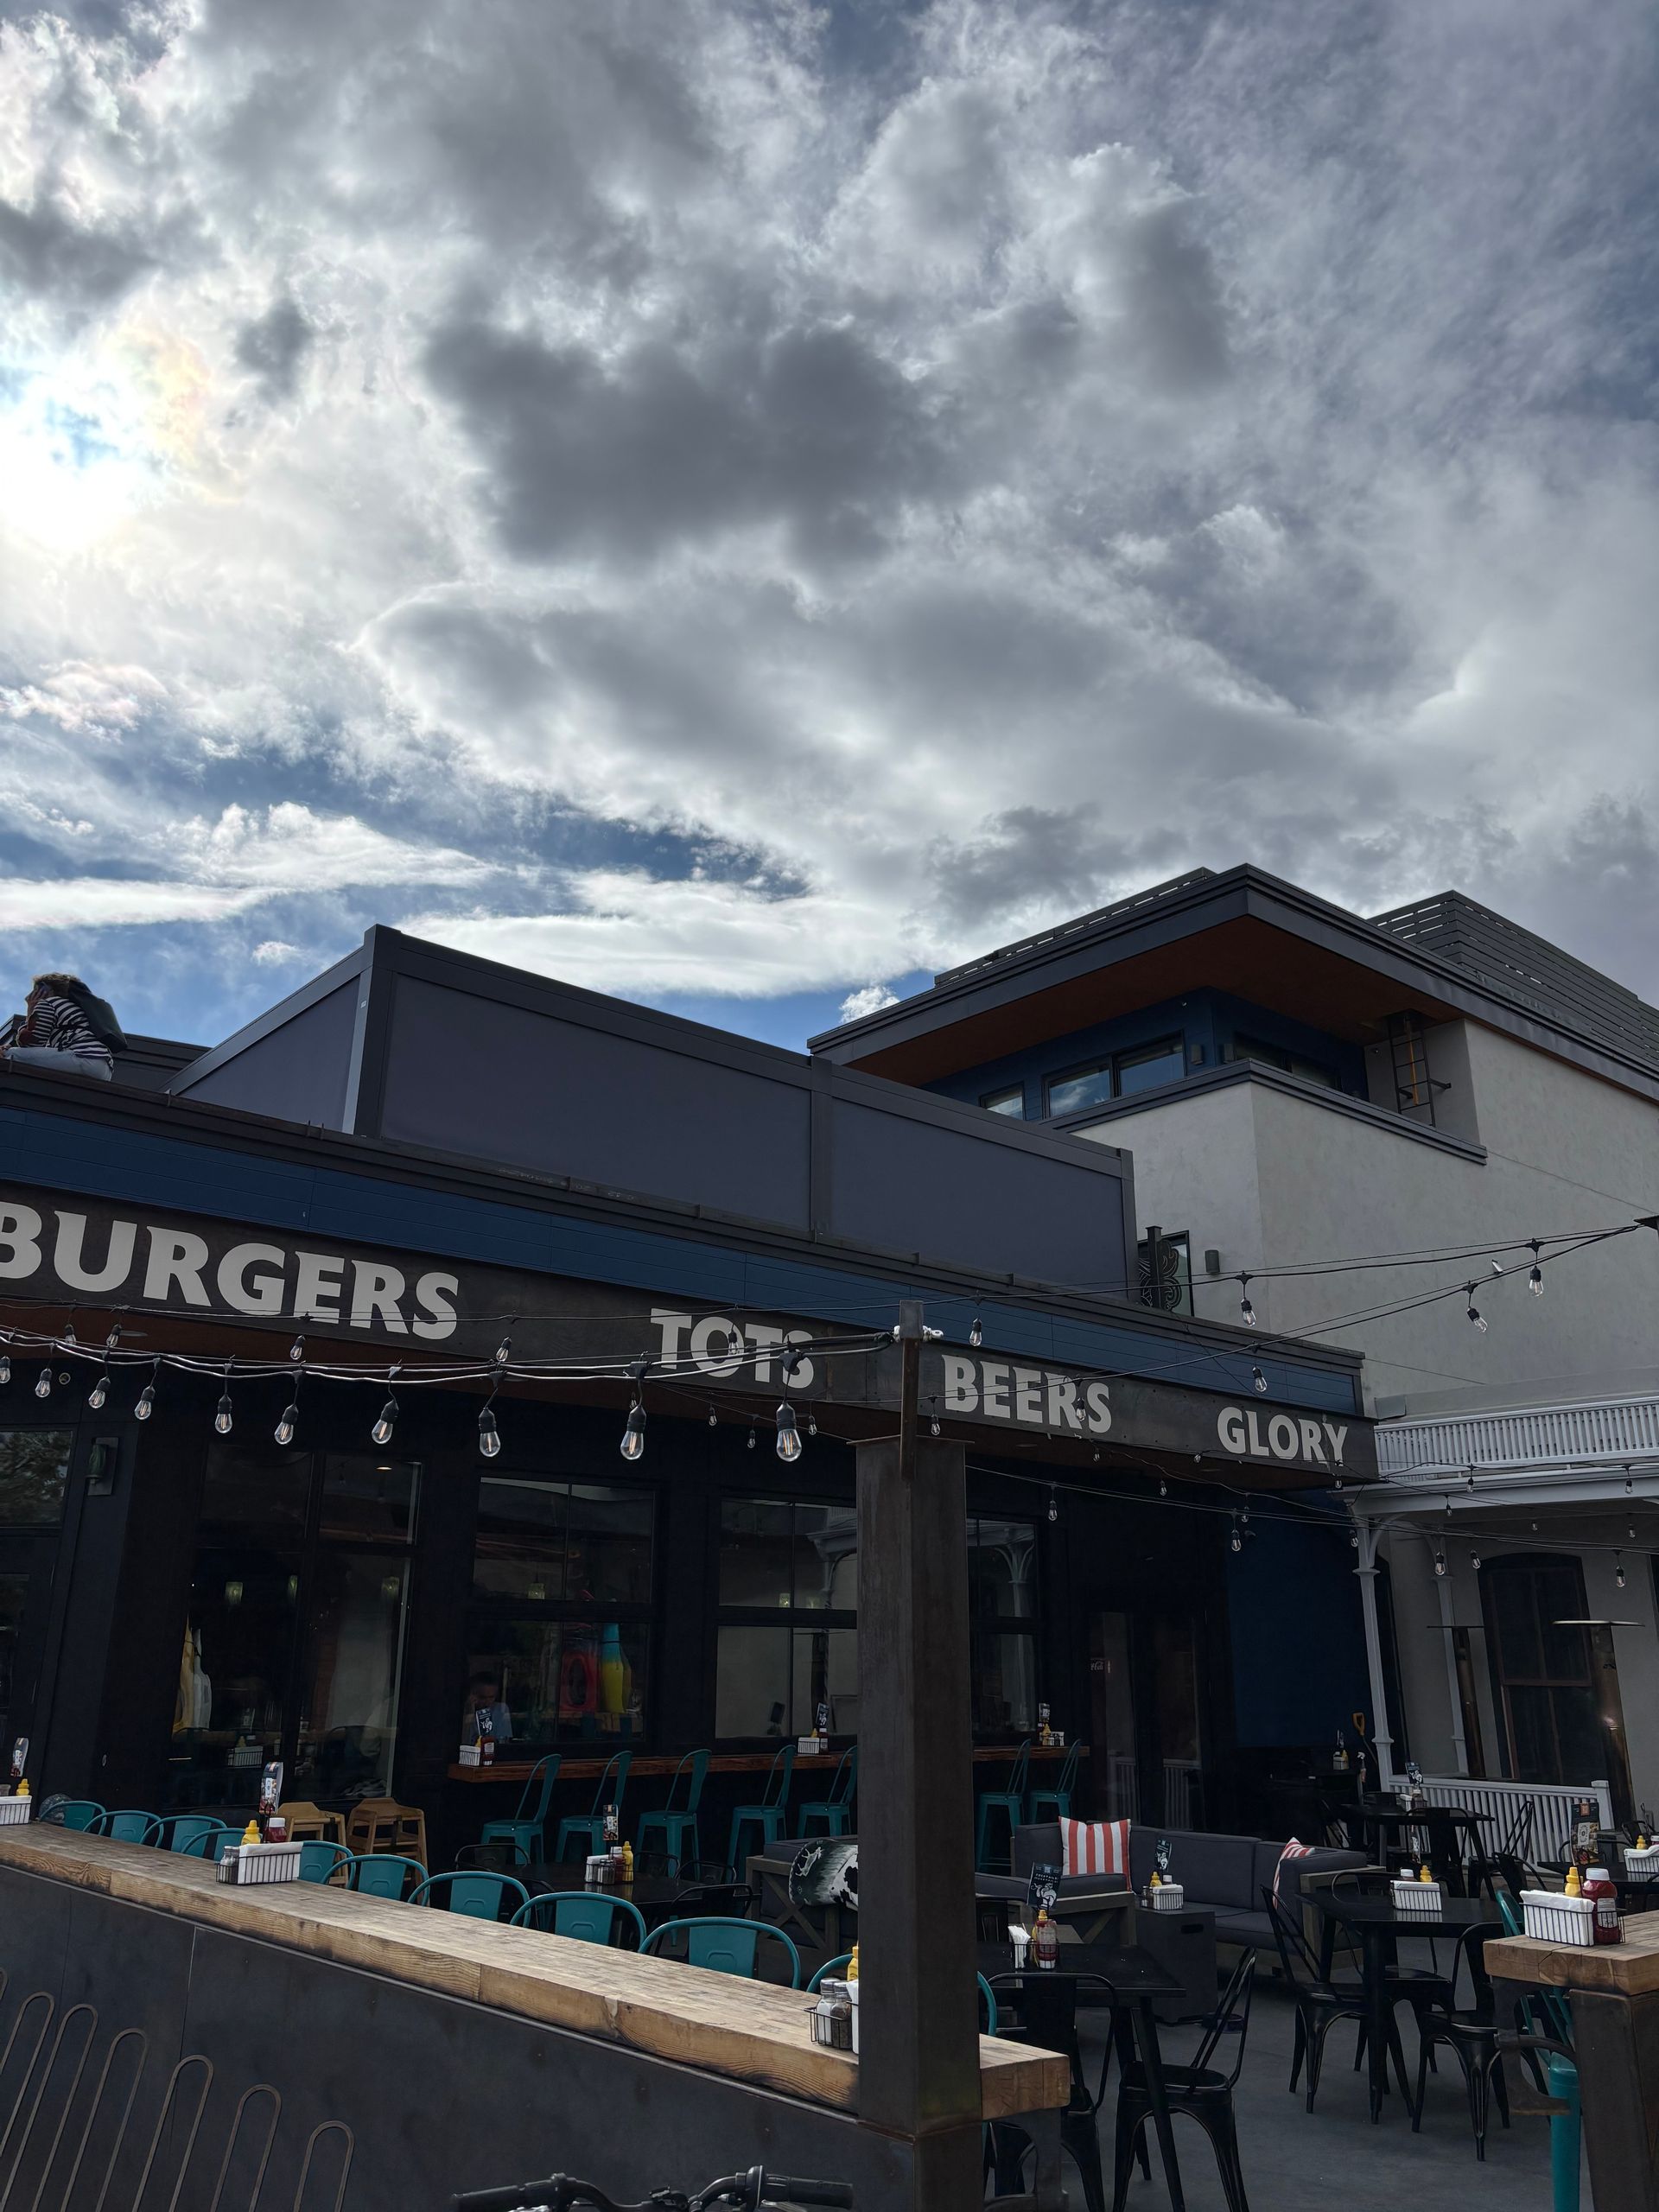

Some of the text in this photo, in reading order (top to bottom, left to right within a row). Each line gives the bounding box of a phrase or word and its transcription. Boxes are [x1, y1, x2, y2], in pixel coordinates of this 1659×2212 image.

[0, 1202, 1348, 1466] BURGERS TOTS BEERS GLORY
